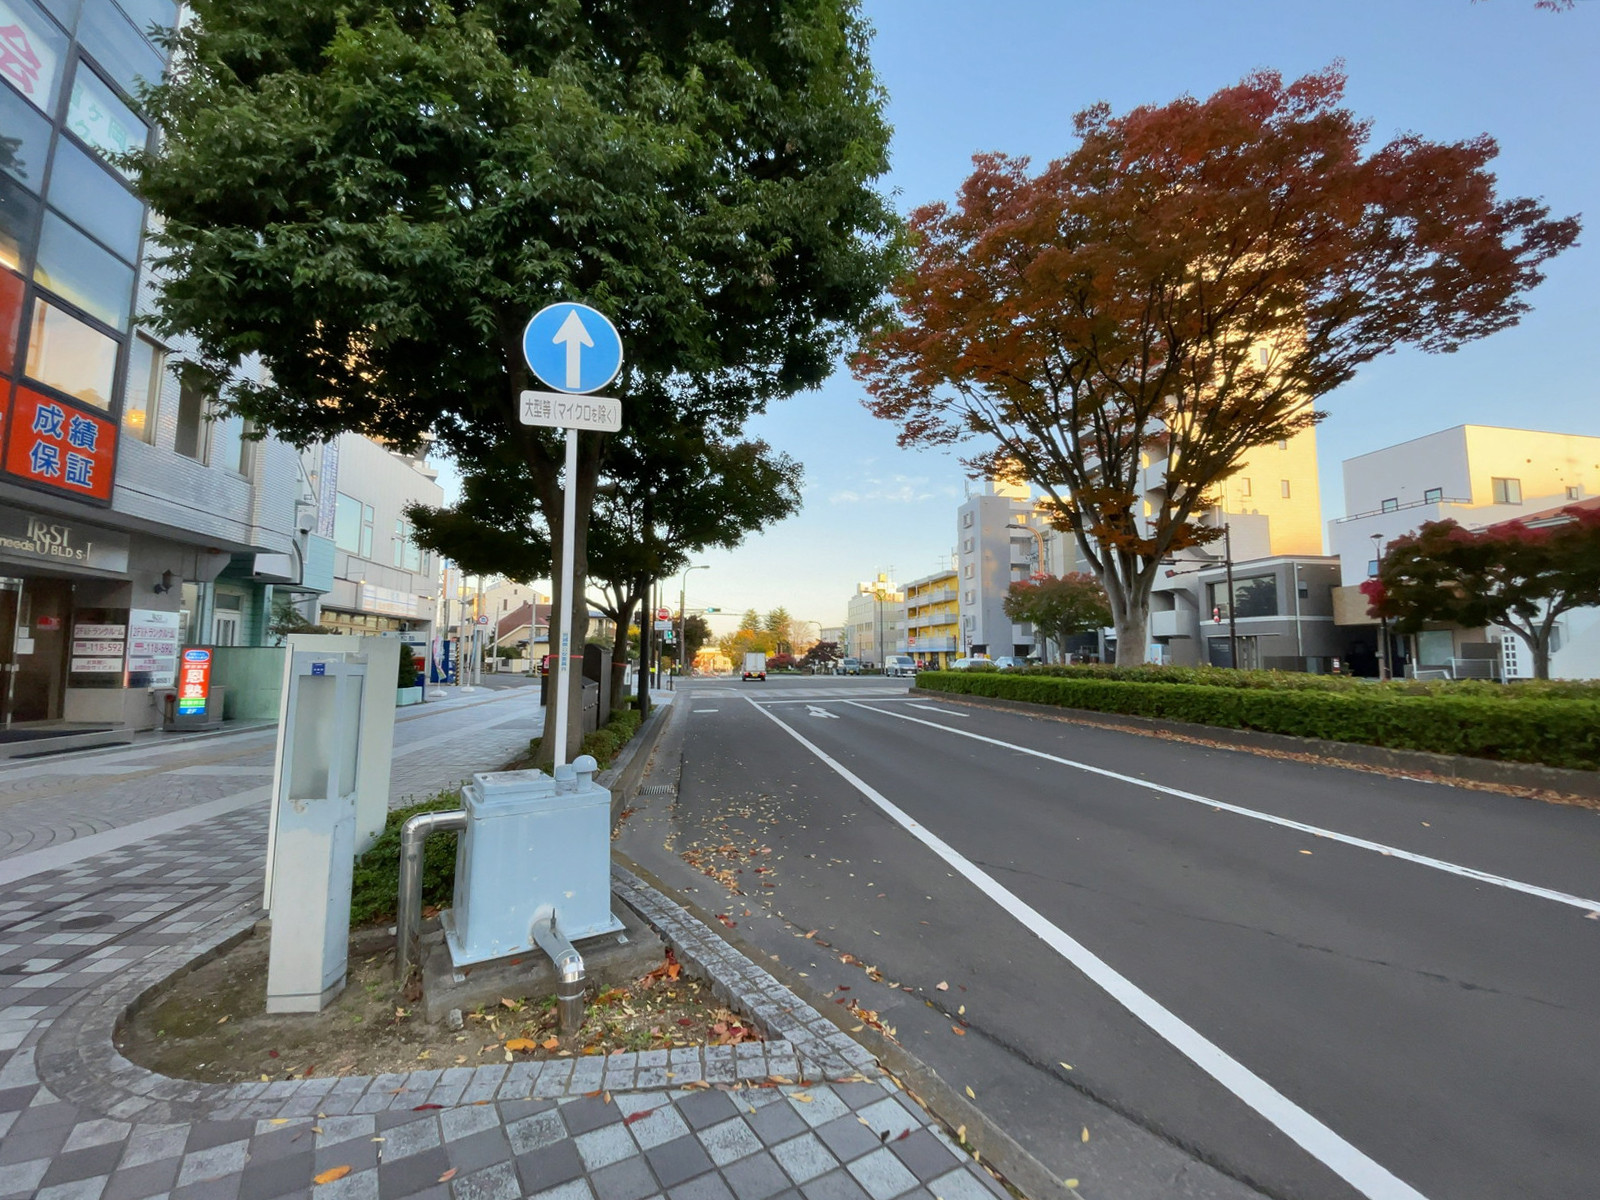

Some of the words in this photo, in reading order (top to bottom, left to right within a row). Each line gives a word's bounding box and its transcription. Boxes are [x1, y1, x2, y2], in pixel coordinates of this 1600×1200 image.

[32, 403, 98, 452] 成績
[30, 440, 95, 488] 保証
[51, 545, 73, 557] BLD
